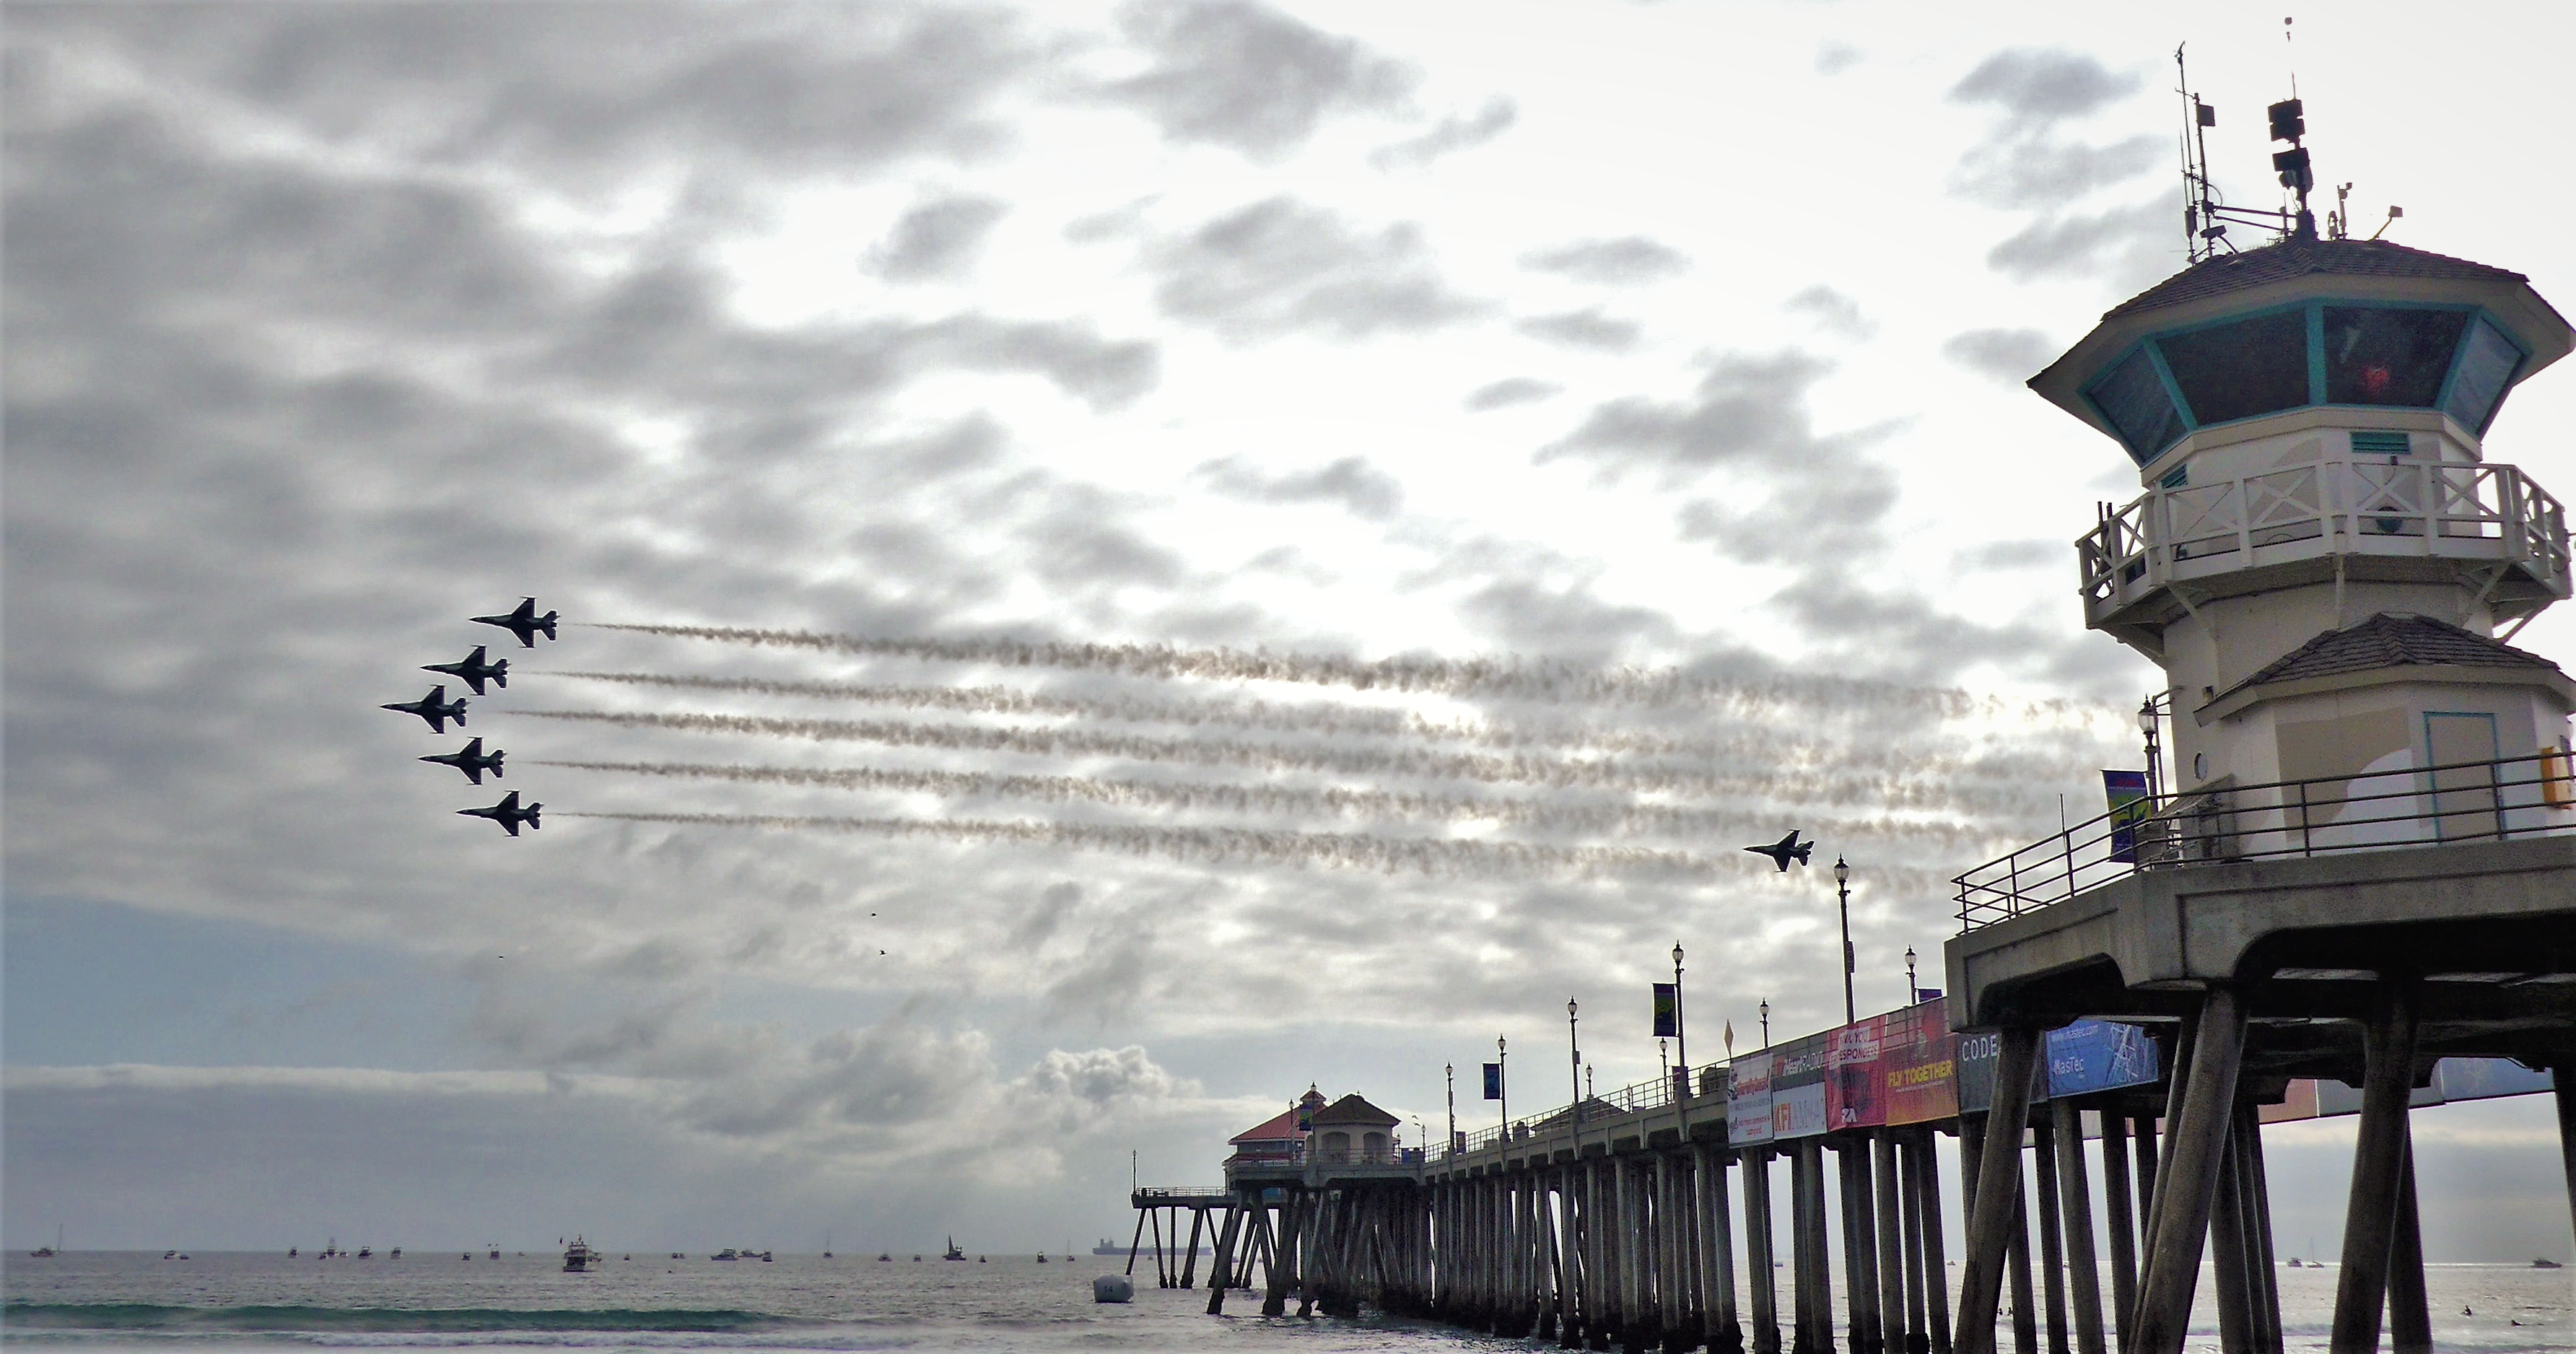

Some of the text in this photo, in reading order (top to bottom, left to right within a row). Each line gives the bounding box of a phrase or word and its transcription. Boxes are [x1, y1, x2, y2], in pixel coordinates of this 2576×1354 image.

[1961, 1034, 1998, 1062] CODE
[1887, 1070, 1902, 1088] FLY
[1903, 1059, 1952, 1085] TOGETHER
